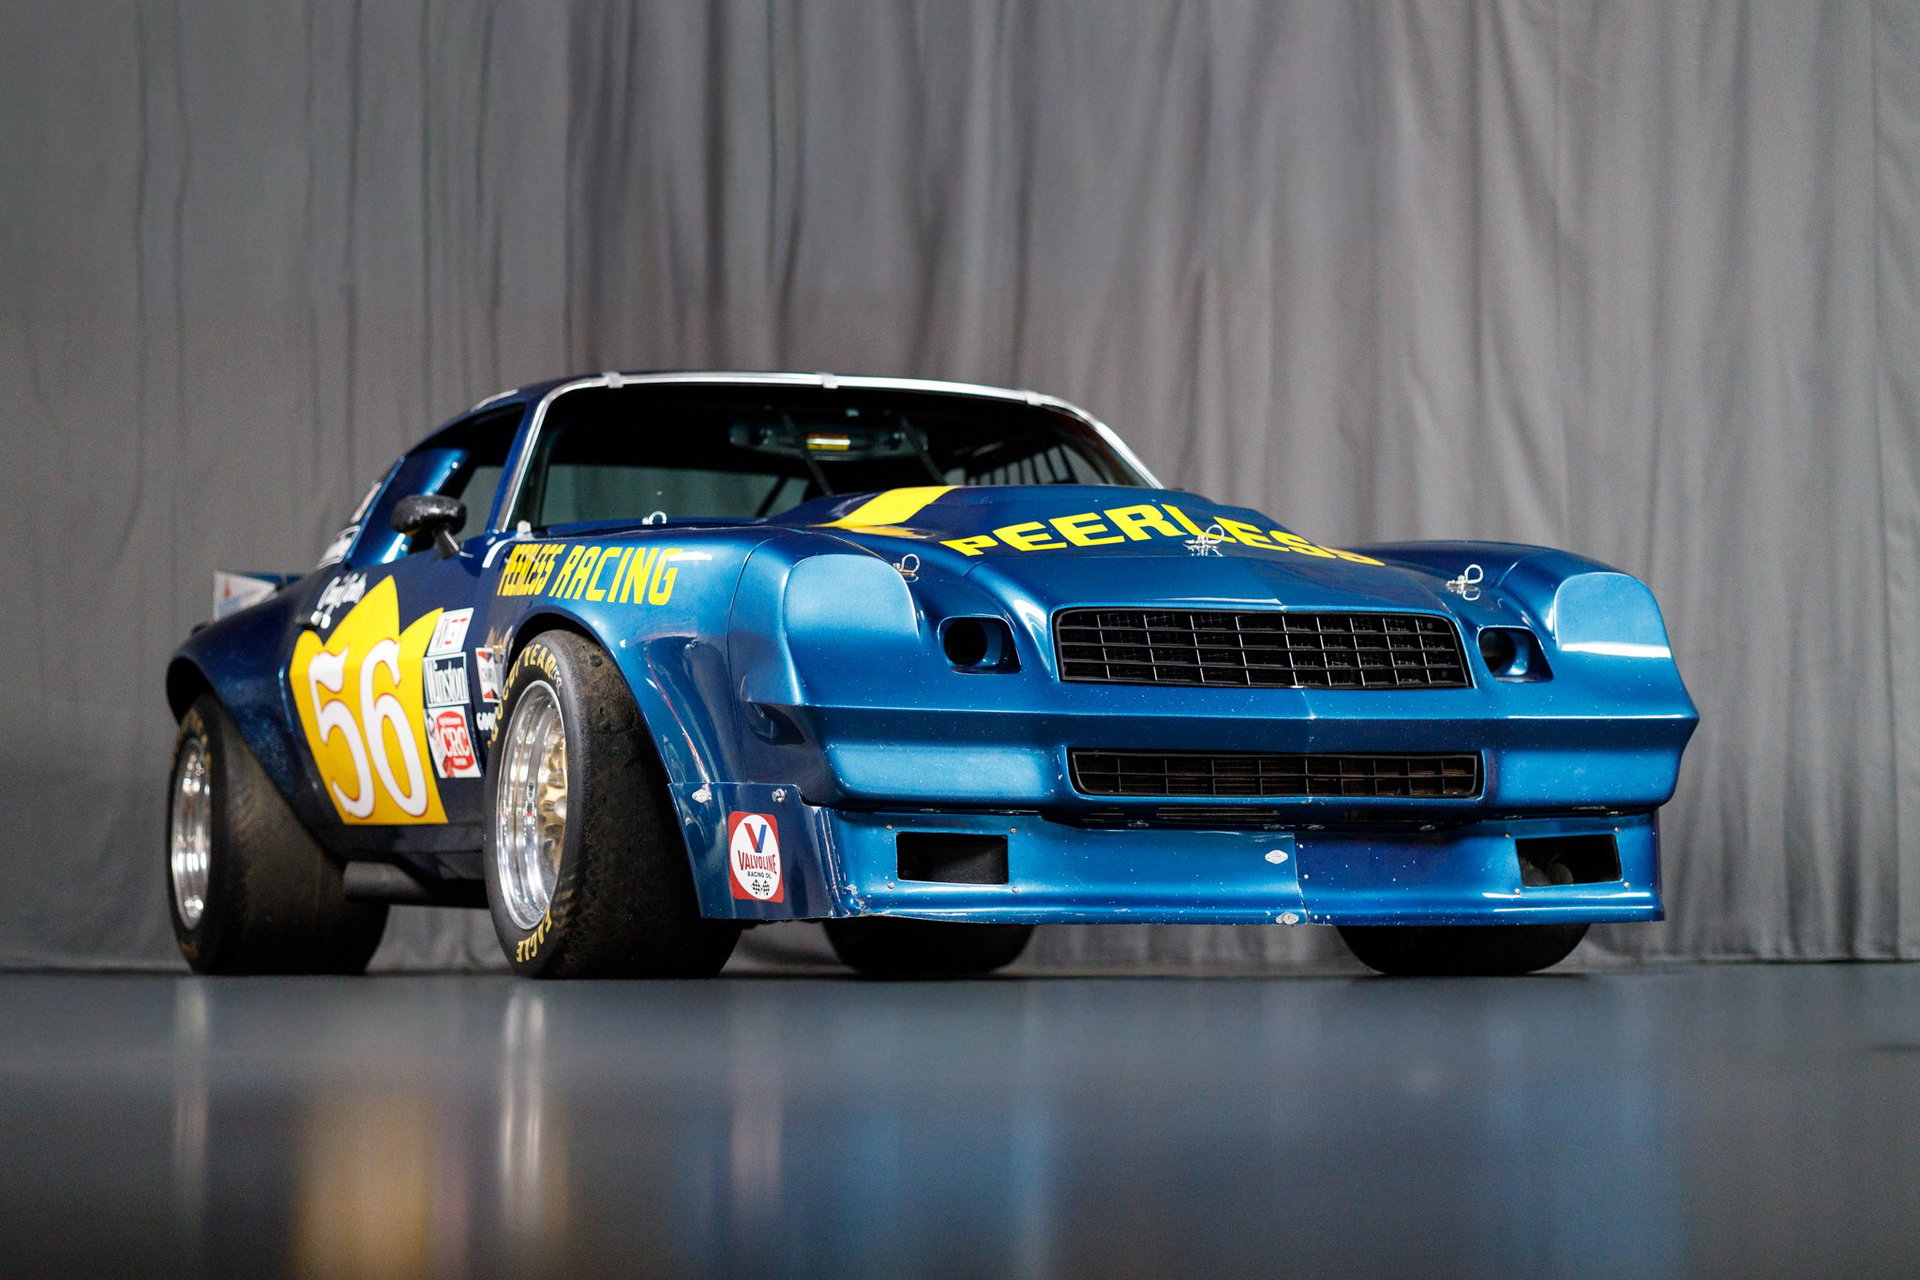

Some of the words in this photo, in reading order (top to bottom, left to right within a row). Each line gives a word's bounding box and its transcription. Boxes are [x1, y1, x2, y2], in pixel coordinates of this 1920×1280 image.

[939, 503, 1386, 567] PEERLESS
[548, 545, 685, 606] RACING
[307, 637, 429, 818] 56
[440, 726, 472, 757] CRC
[737, 849, 778, 875] VALVOLINE
[747, 870, 765, 879] RACING
